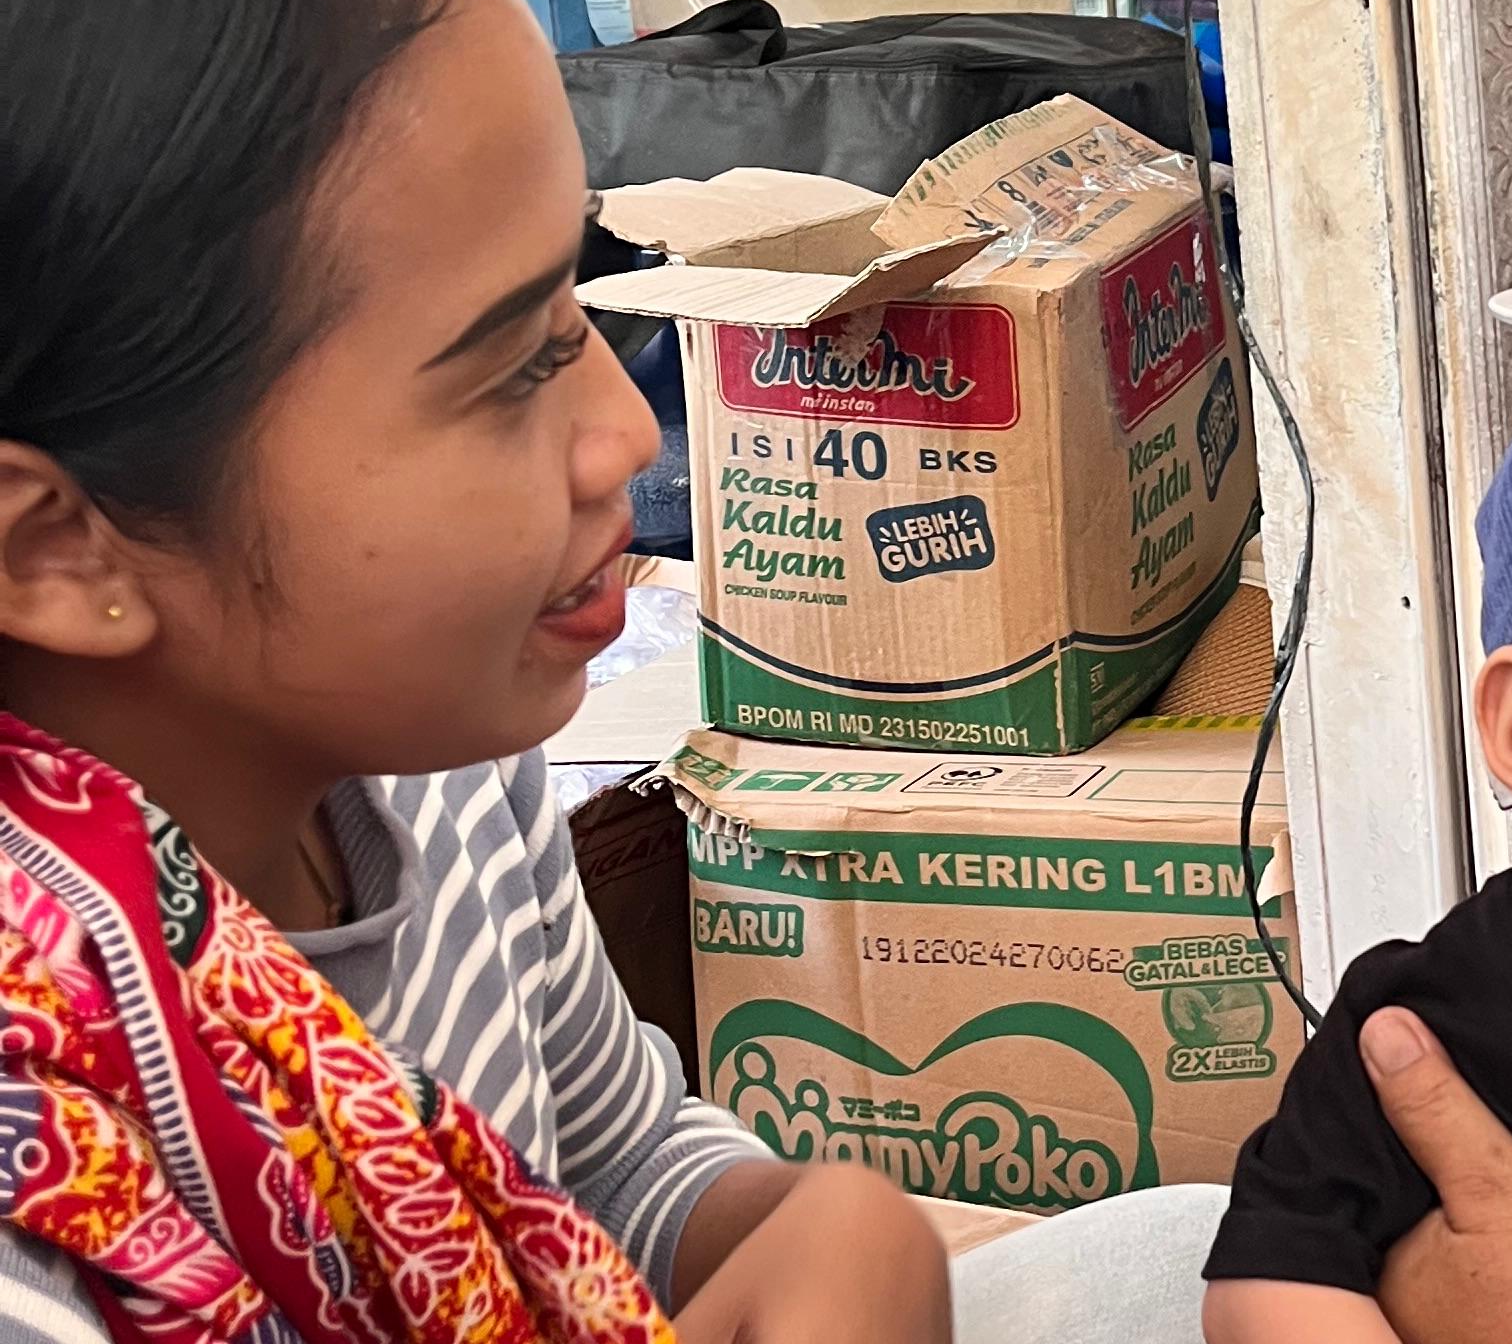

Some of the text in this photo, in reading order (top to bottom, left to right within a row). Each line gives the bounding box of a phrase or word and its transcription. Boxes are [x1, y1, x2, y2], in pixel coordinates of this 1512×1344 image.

[823, 393, 876, 413] instan
[813, 427, 888, 481] 40
[919, 448, 999, 474] BKS
[1128, 422, 1176, 483] Rasa
[719, 466, 819, 500] Rasa
[1130, 457, 1192, 538] Kaldu
[722, 498, 843, 542] Kaldu
[892, 509, 959, 543] LEBIH
[722, 538, 847, 582] Ayam
[880, 527, 988, 573] GURIH
[1130, 511, 1195, 591] Ayam
[724, 583, 848, 606] CHICKEN SOUP FLAVOUR
[737, 703, 1031, 748] BPOM RI MD 231502251001
[918, 852, 1107, 893] KERING
[697, 910, 797, 949] BARU!
[860, 936, 1126, 975] 19122024270062
[1166, 938, 1244, 961] BEBAS
[1171, 1050, 1213, 1075] 2X
[1214, 1047, 1254, 1060] LEBIH
[1214, 1057, 1268, 1072] ELASTIS
